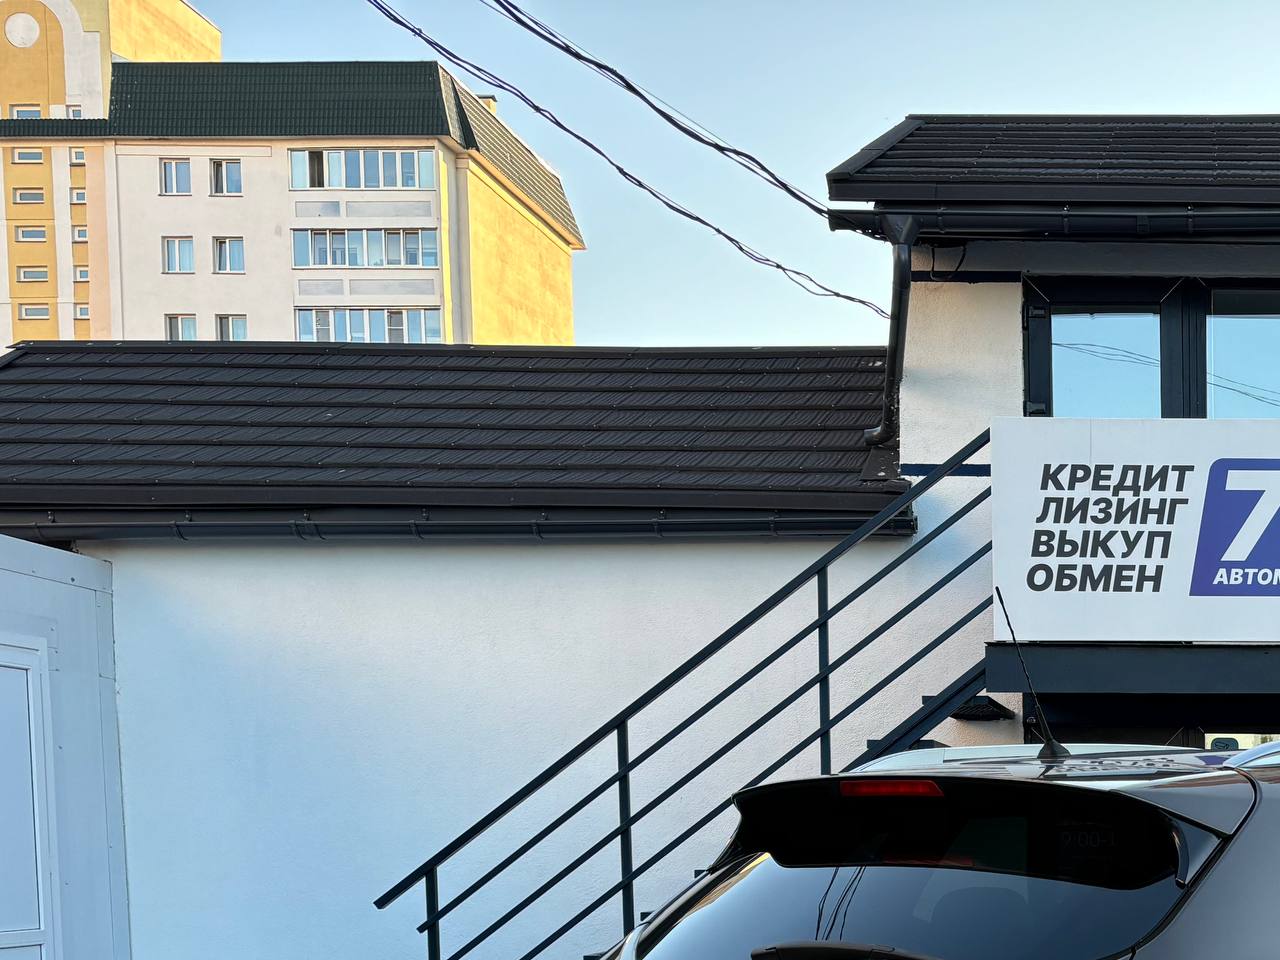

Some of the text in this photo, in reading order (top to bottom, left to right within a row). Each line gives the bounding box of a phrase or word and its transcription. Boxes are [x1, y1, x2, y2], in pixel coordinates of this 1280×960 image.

[1040, 463, 1195, 497] КРЕДИТ
[1035, 497, 1189, 525] ЛИЗИНГ
[1031, 530, 1172, 558] ВЫКУП
[1026, 563, 1164, 592] ОБМЕН
